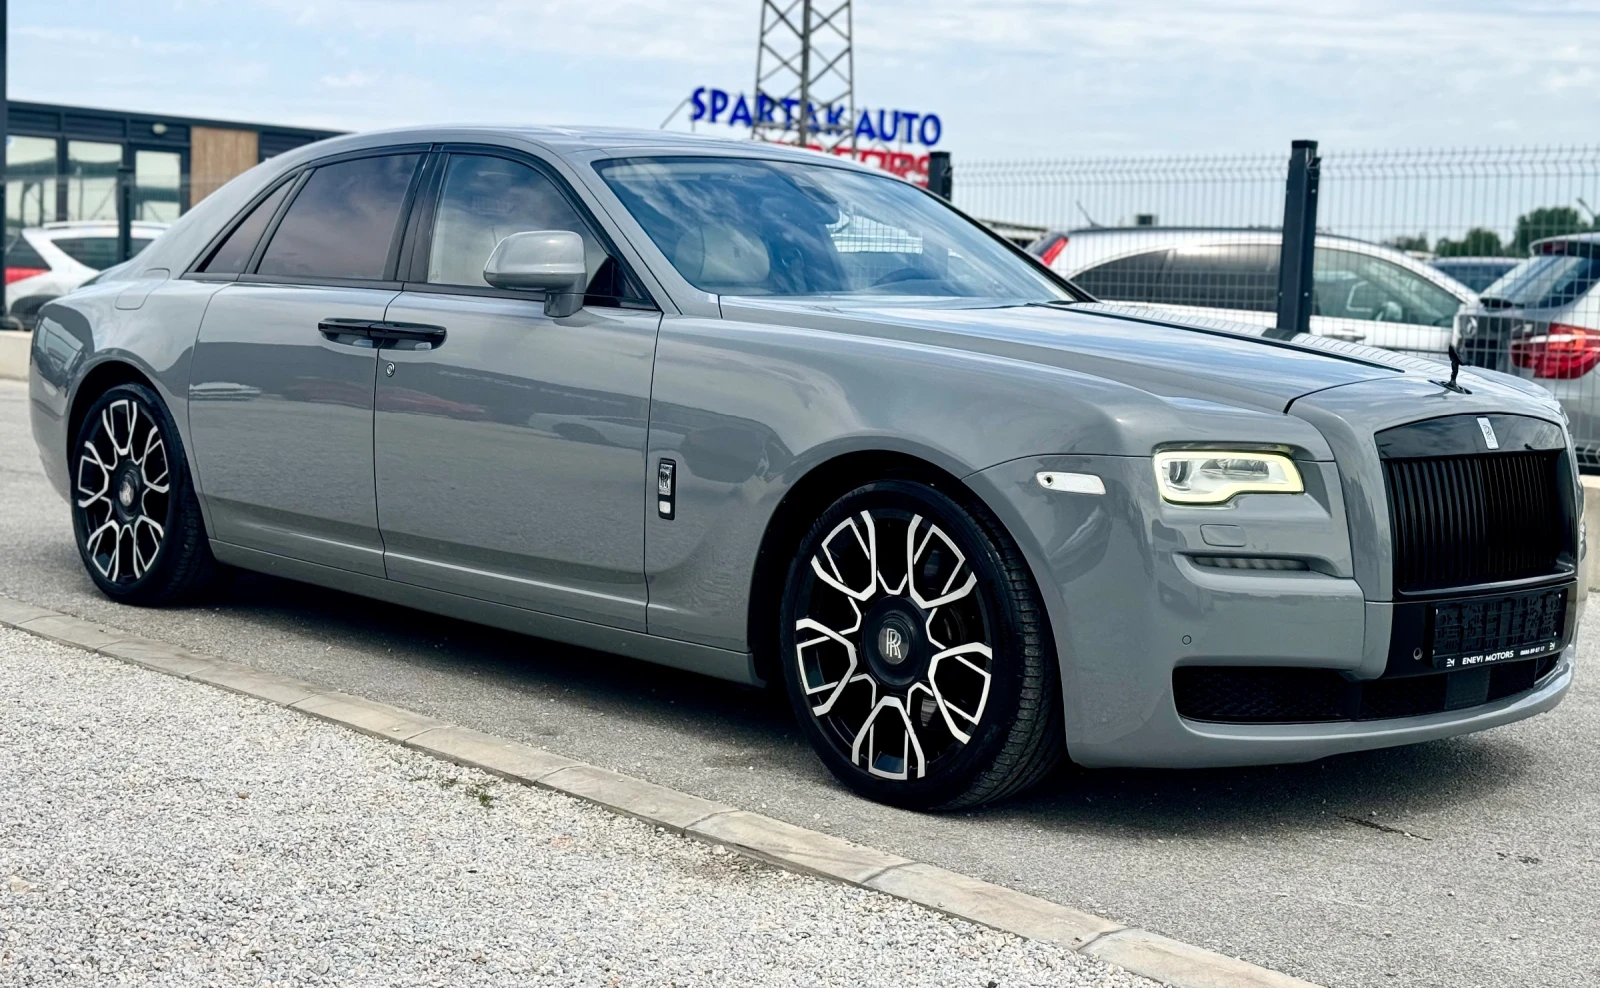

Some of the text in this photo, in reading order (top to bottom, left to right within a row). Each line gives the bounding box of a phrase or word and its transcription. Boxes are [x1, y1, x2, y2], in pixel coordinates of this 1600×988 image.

[691, 87, 941, 146] SPARTAK AUTO
[886, 628, 902, 659] RR
[1462, 655, 1483, 665] ENEVI
[1485, 650, 1514, 662] MOTORS
